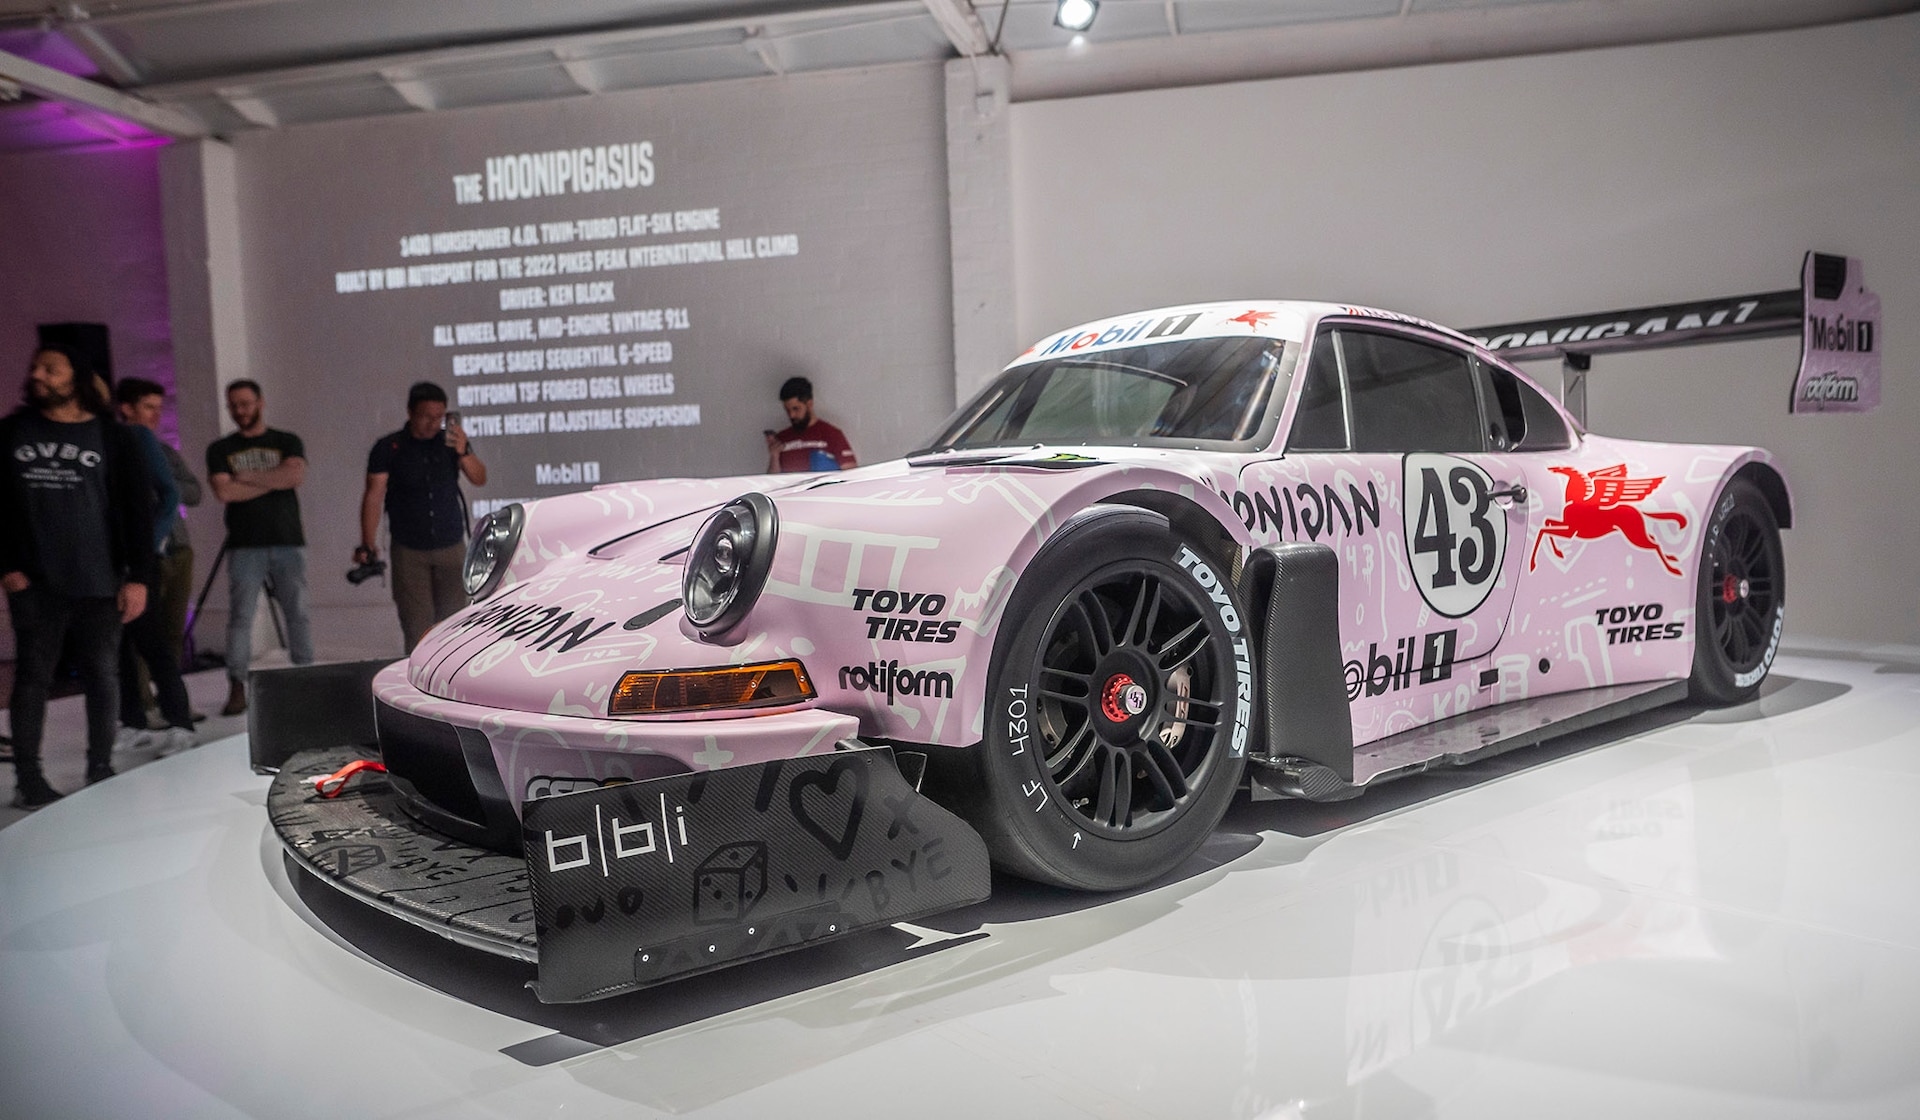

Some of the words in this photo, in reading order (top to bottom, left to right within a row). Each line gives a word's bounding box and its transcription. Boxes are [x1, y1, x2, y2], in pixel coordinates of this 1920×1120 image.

[453, 174, 483, 204] THE
[486, 141, 655, 202] HOONIPIGASUS
[541, 216, 617, 244] TWIN-TURBO
[619, 211, 673, 237] FLAT-SIX
[674, 207, 720, 232] ENGINE
[475, 259, 498, 281] FOR
[499, 256, 522, 279] THE
[524, 253, 556, 277] 2022
[557, 250, 593, 275] PIKES
[595, 248, 627, 272] PEAK
[629, 241, 724, 269] INTERNATIONAL
[726, 237, 754, 261] HILL
[756, 233, 799, 258] CLIMB
[500, 286, 547, 311] DRIVER:
[549, 284, 573, 307] KEN
[576, 280, 615, 303] BLOCK
[433, 325, 454, 347] ALL
[455, 321, 497, 346] WHEEL
[498, 318, 537, 343] DRIVE,
[538, 313, 611, 340] MID-ENGINE
[612, 308, 664, 335] VINTAGE
[665, 307, 690, 330] 911
[1040, 319, 1153, 356] Mobil
[1810, 314, 1854, 352] Mobil
[453, 352, 505, 376] BESPOKE
[507, 350, 544, 374] SADEV
[546, 345, 618, 371] SEQUENTIAL
[457, 382, 516, 407] ROTIFORM
[541, 378, 588, 401] FORGED
[623, 373, 675, 396] WHEELS
[504, 411, 546, 435] HEIGHT
[549, 407, 622, 433] ADJUSTABLE
[624, 403, 700, 428] SUSPENSION
[536, 462, 581, 485] Mobil
[1414, 467, 1497, 589] 43
[852, 588, 946, 616] TOYO
[1596, 604, 1664, 626] TOYO
[866, 616, 961, 643] TIRES
[1607, 622, 1685, 646] TIRES
[1764, 605, 1785, 667] TOYO
[1178, 547, 1241, 632] TOYO
[1230, 637, 1251, 758] TIRES
[839, 660, 953, 706] rotiform
[1008, 683, 1030, 756] 4301
[1021, 779, 1049, 813] LF
